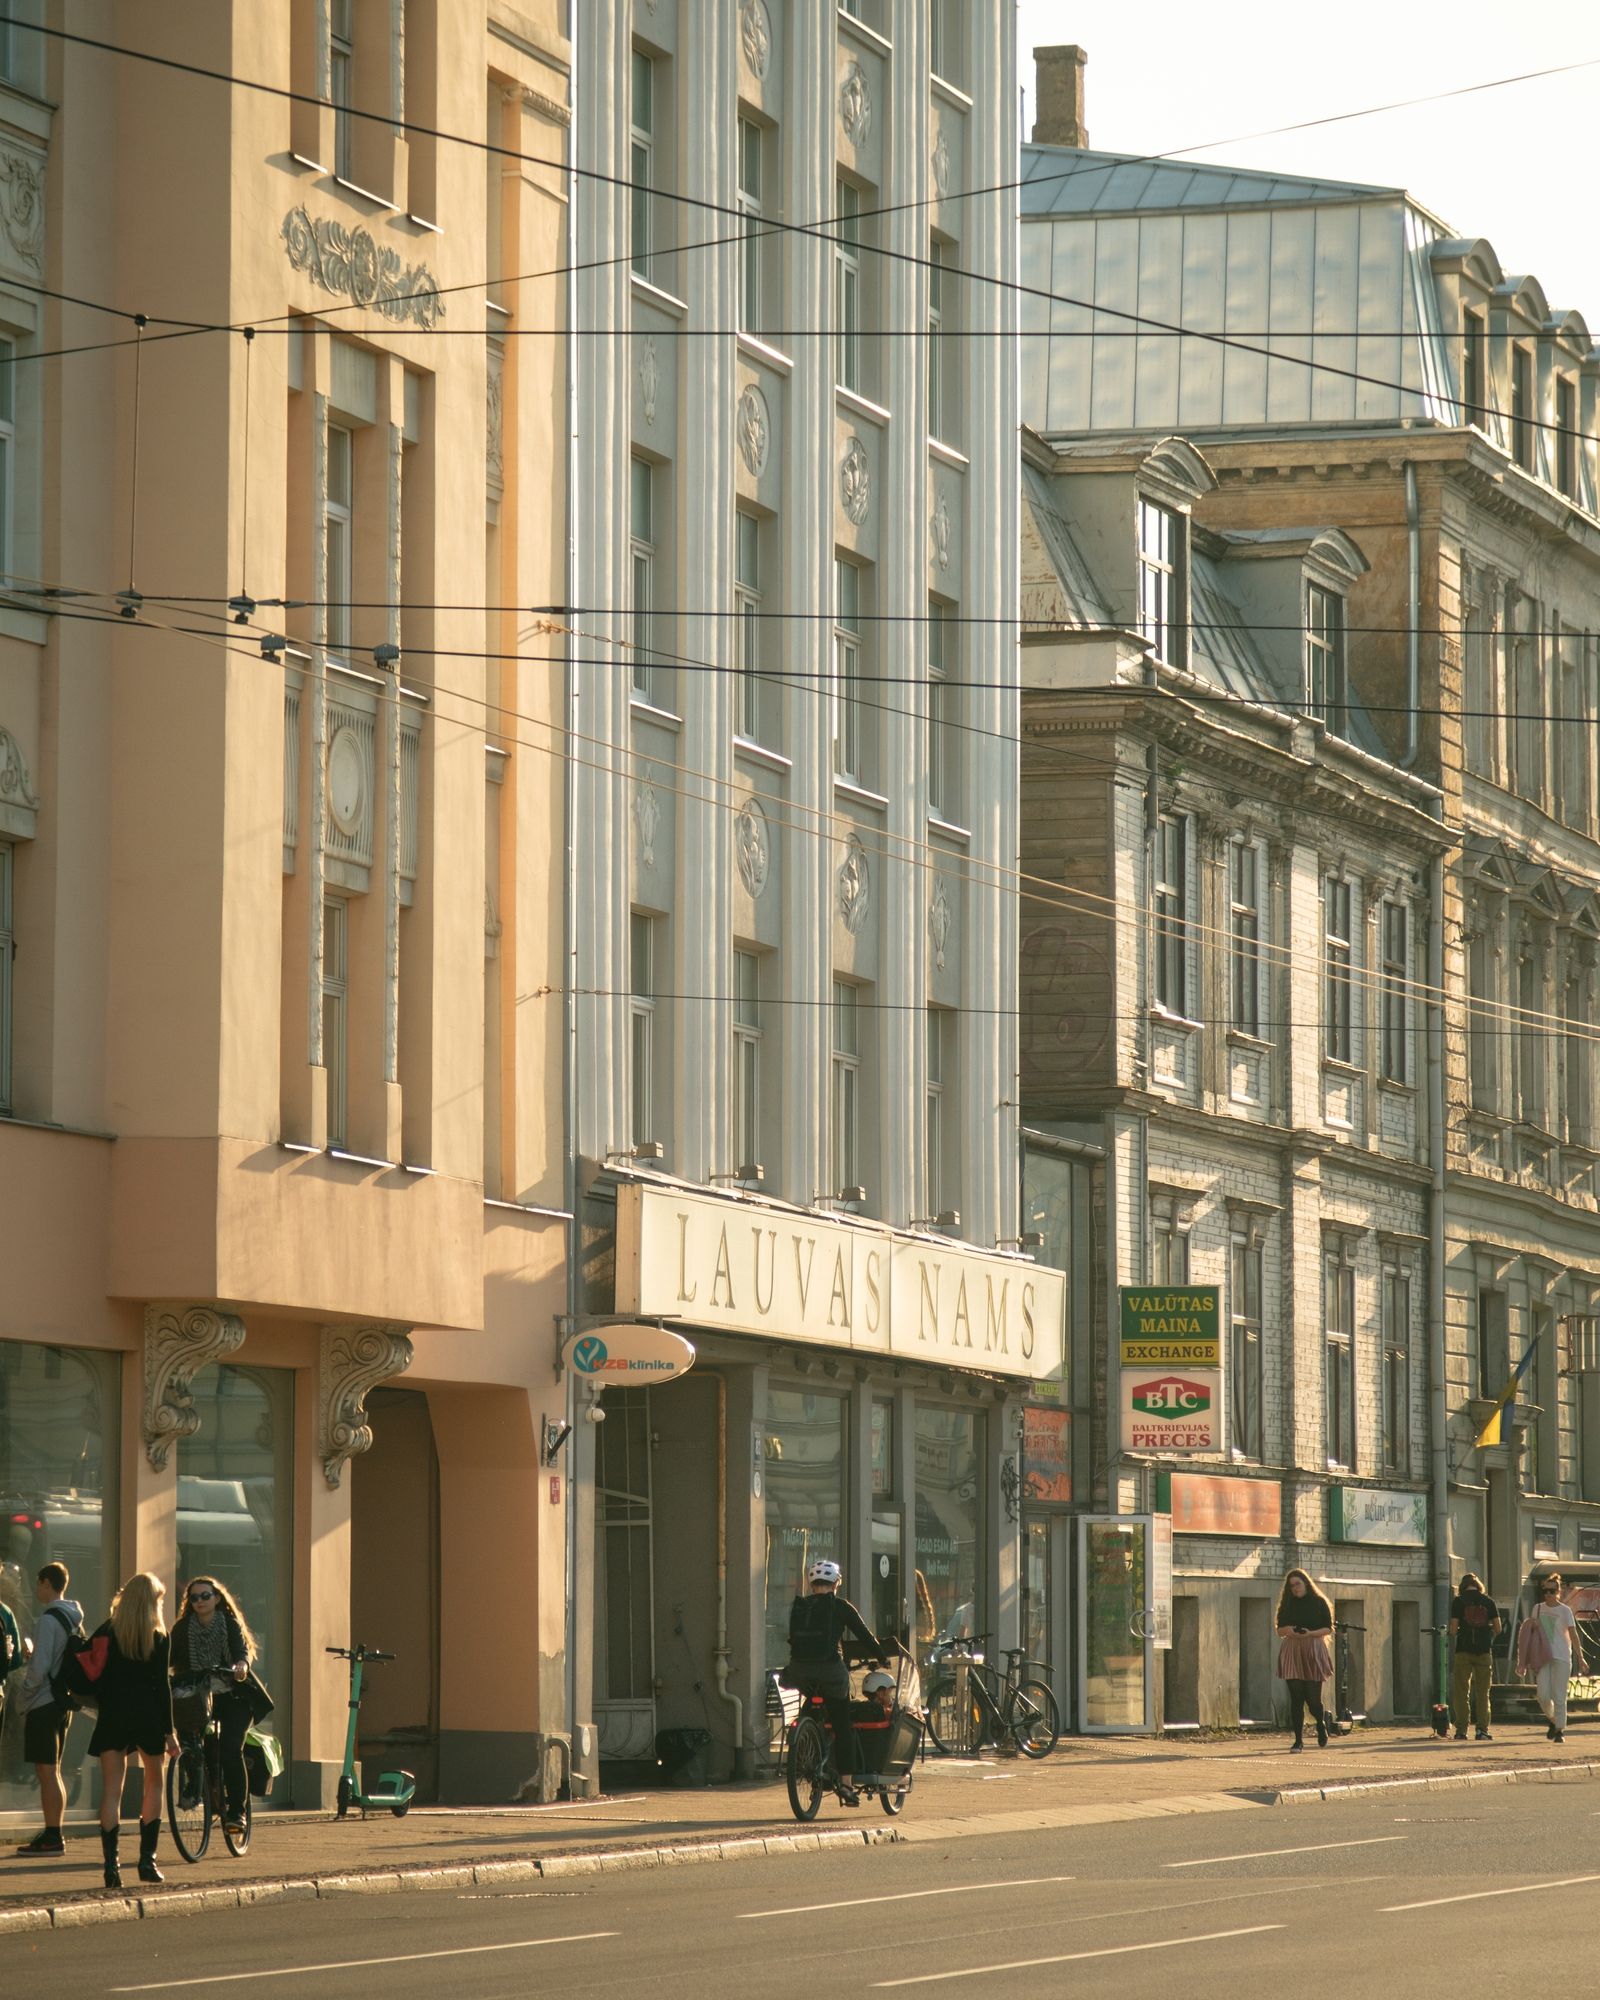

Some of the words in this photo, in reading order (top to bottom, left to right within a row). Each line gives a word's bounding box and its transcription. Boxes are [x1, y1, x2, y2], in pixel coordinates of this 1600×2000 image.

[676, 1212, 881, 1335] LAUVAS
[918, 1260, 1036, 1361] NAMS
[1127, 1294, 1214, 1312] VALŪTAS
[1140, 1318, 1202, 1336] MAIŅA
[1126, 1346, 1215, 1358] EXCHANGE
[1145, 1383, 1199, 1409] BTC
[1132, 1424, 1210, 1432] BALTKRIEVIJAS
[1132, 1433, 1211, 1447] PRECES
